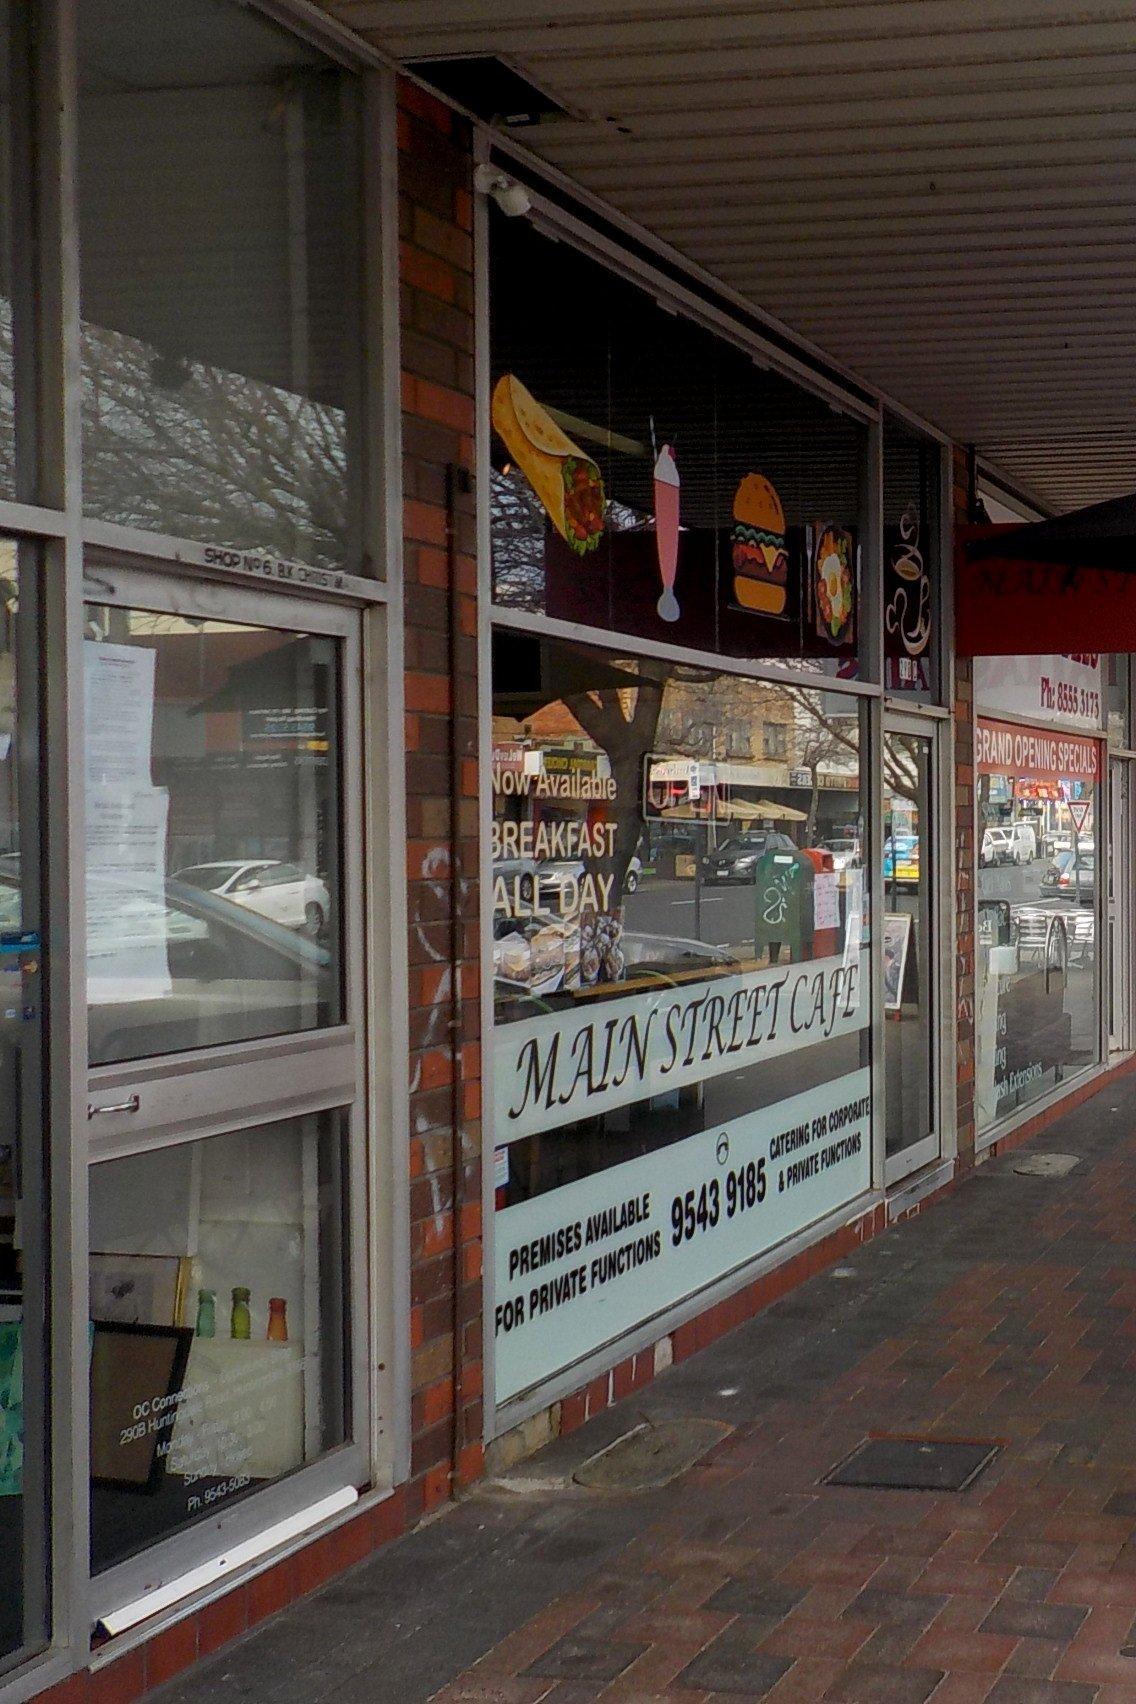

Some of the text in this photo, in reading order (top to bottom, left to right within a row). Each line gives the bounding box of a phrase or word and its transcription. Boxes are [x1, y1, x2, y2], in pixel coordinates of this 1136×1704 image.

[1057, 681, 1079, 714] 8555
[976, 727, 1097, 774] GRAND OPENING SPECIALS
[536, 767, 618, 800] Available
[491, 821, 618, 859] BREAKFAST
[493, 873, 615, 918] ALL DAY
[508, 963, 860, 1120] MAIN STREET CAFE
[769, 1095, 872, 1162] CATERING FOR CORPORATE
[777, 1131, 862, 1194] & PRIVATE FUNCTIONS
[670, 1156, 767, 1248] 9543 9185
[508, 1192, 651, 1282] PREMISES AVAILABLE
[494, 1230, 661, 1339] FOR PRIVATE FUNCTIONS
